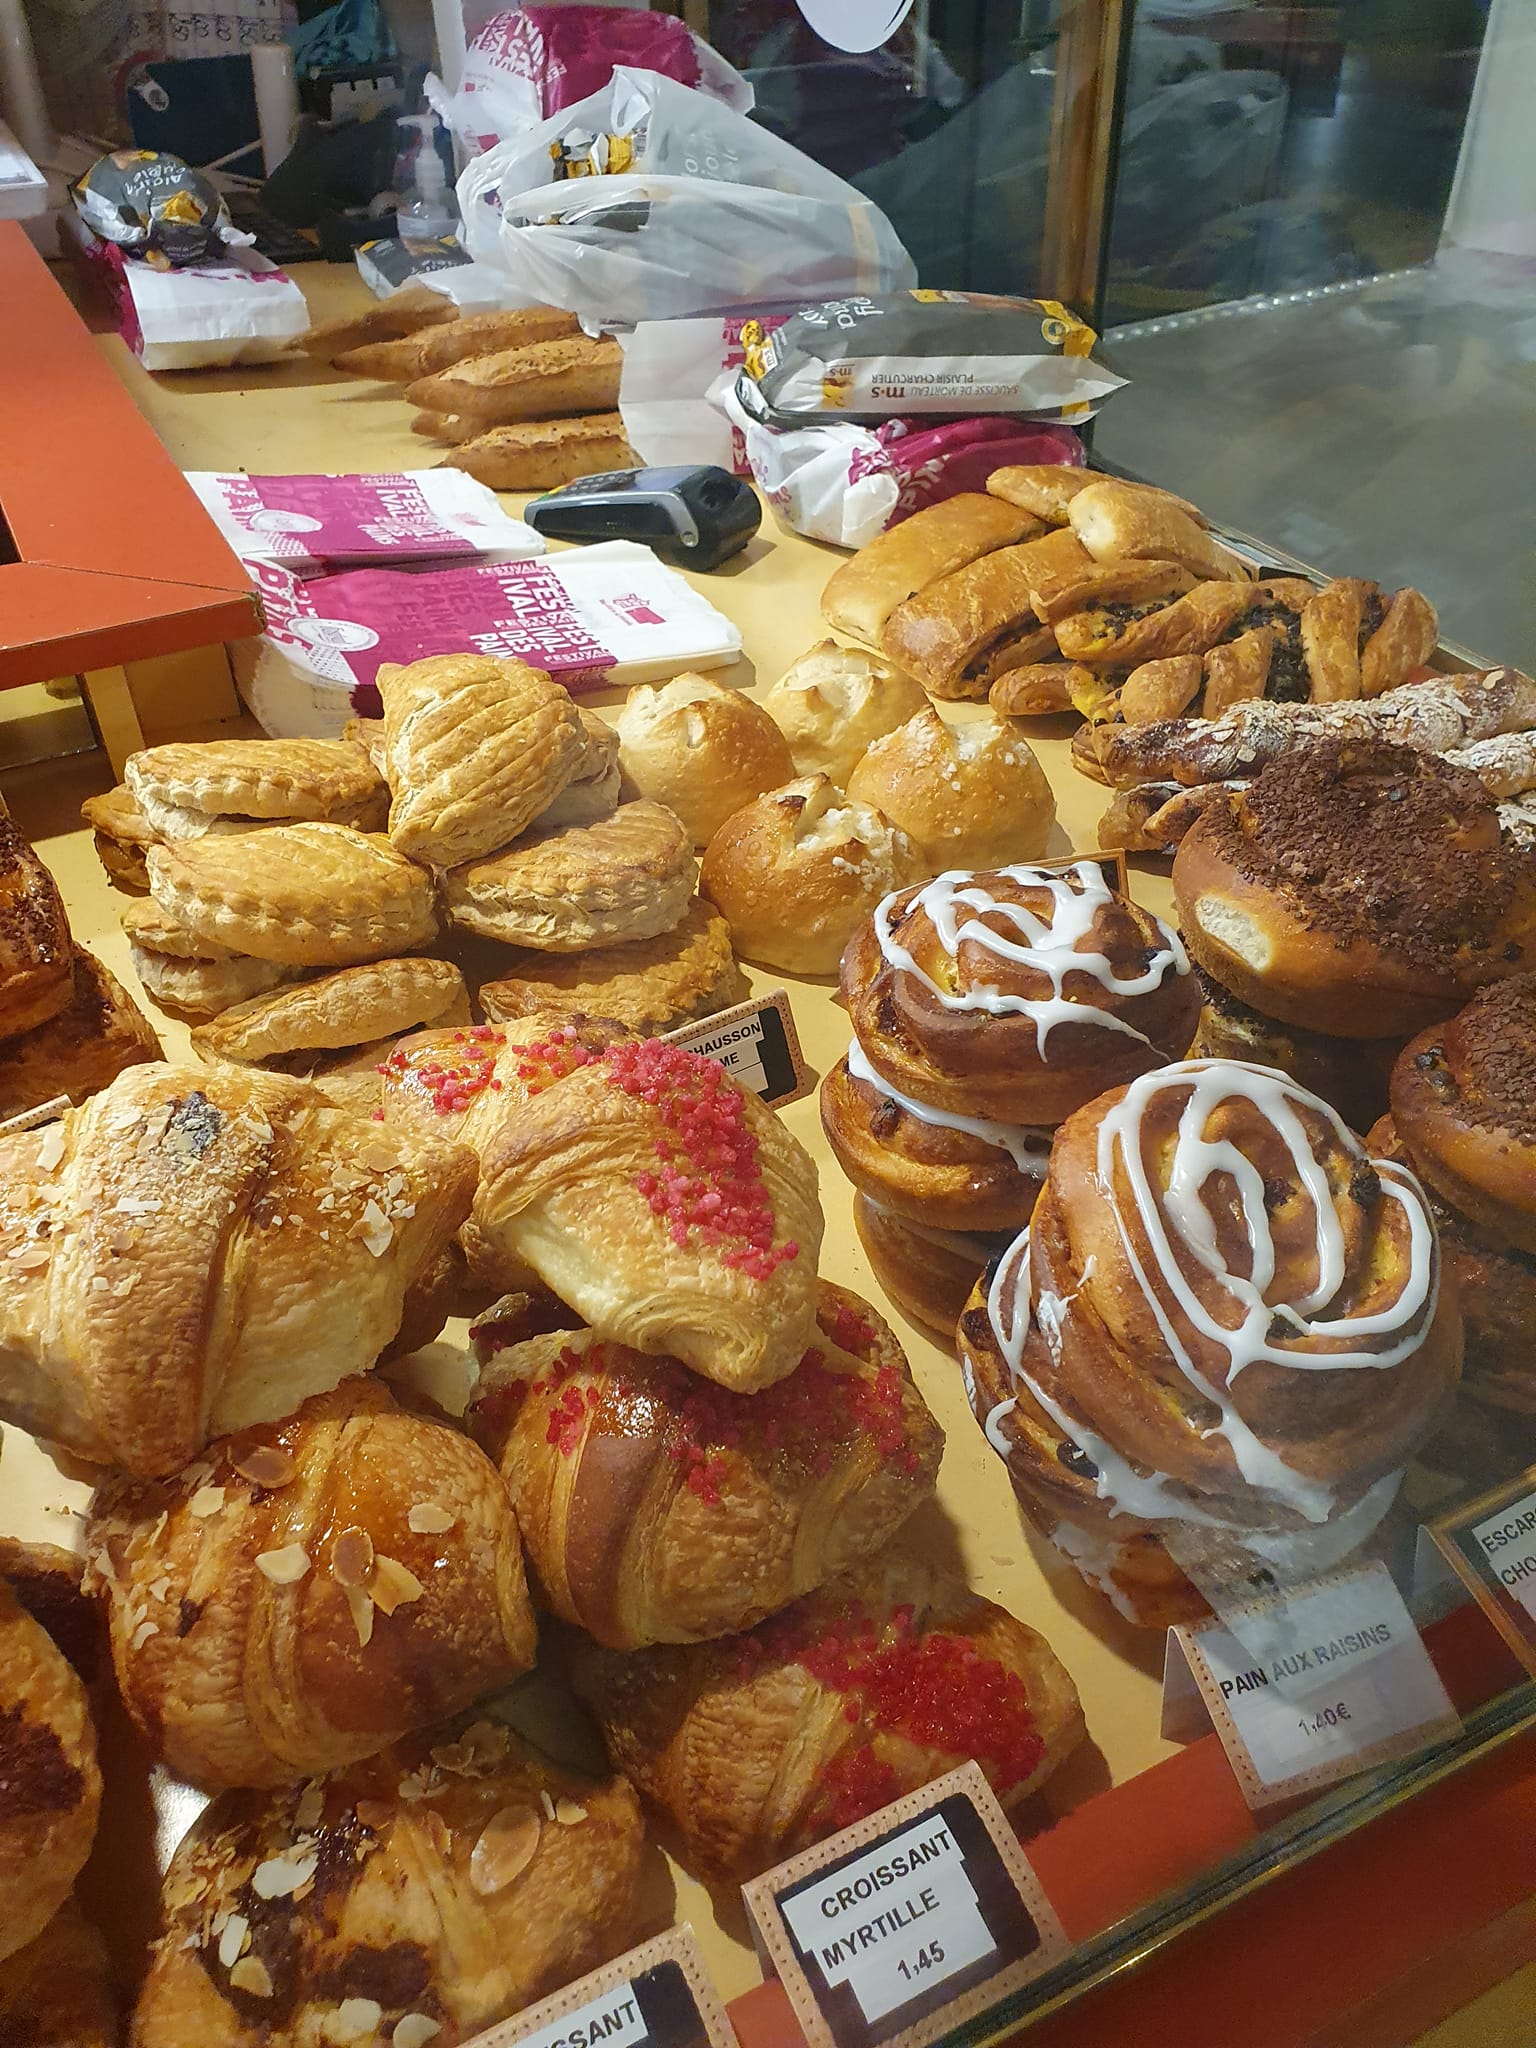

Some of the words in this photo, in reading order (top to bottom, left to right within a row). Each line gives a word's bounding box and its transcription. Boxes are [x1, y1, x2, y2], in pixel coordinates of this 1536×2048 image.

[871, 374, 934, 384] CHARCUTIER
[910, 386, 957, 396] MORTEAU
[935, 374, 974, 384] PLAISIR
[960, 386, 972, 395] DE
[974, 385, 1019, 395] SAUCISSE
[498, 578, 541, 618] IVAL
[469, 633, 517, 659] PAIN
[500, 629, 542, 653] DES
[526, 626, 572, 653] IVAL
[688, 1022, 761, 1055] HAUSSON
[719, 1052, 740, 1068] ME
[1482, 1508, 1536, 1553] ESCAR
[1220, 1667, 1269, 1700] PAIN
[1272, 1653, 1314, 1684] AUX
[1312, 1623, 1391, 1668] RAISINS
[1299, 1702, 1351, 1737] 1,40€
[821, 1830, 952, 1919] CROISSANT
[822, 1888, 940, 1969] MYRTILLE
[897, 1940, 946, 1981] 1,45
[544, 1999, 636, 2048] SANT
